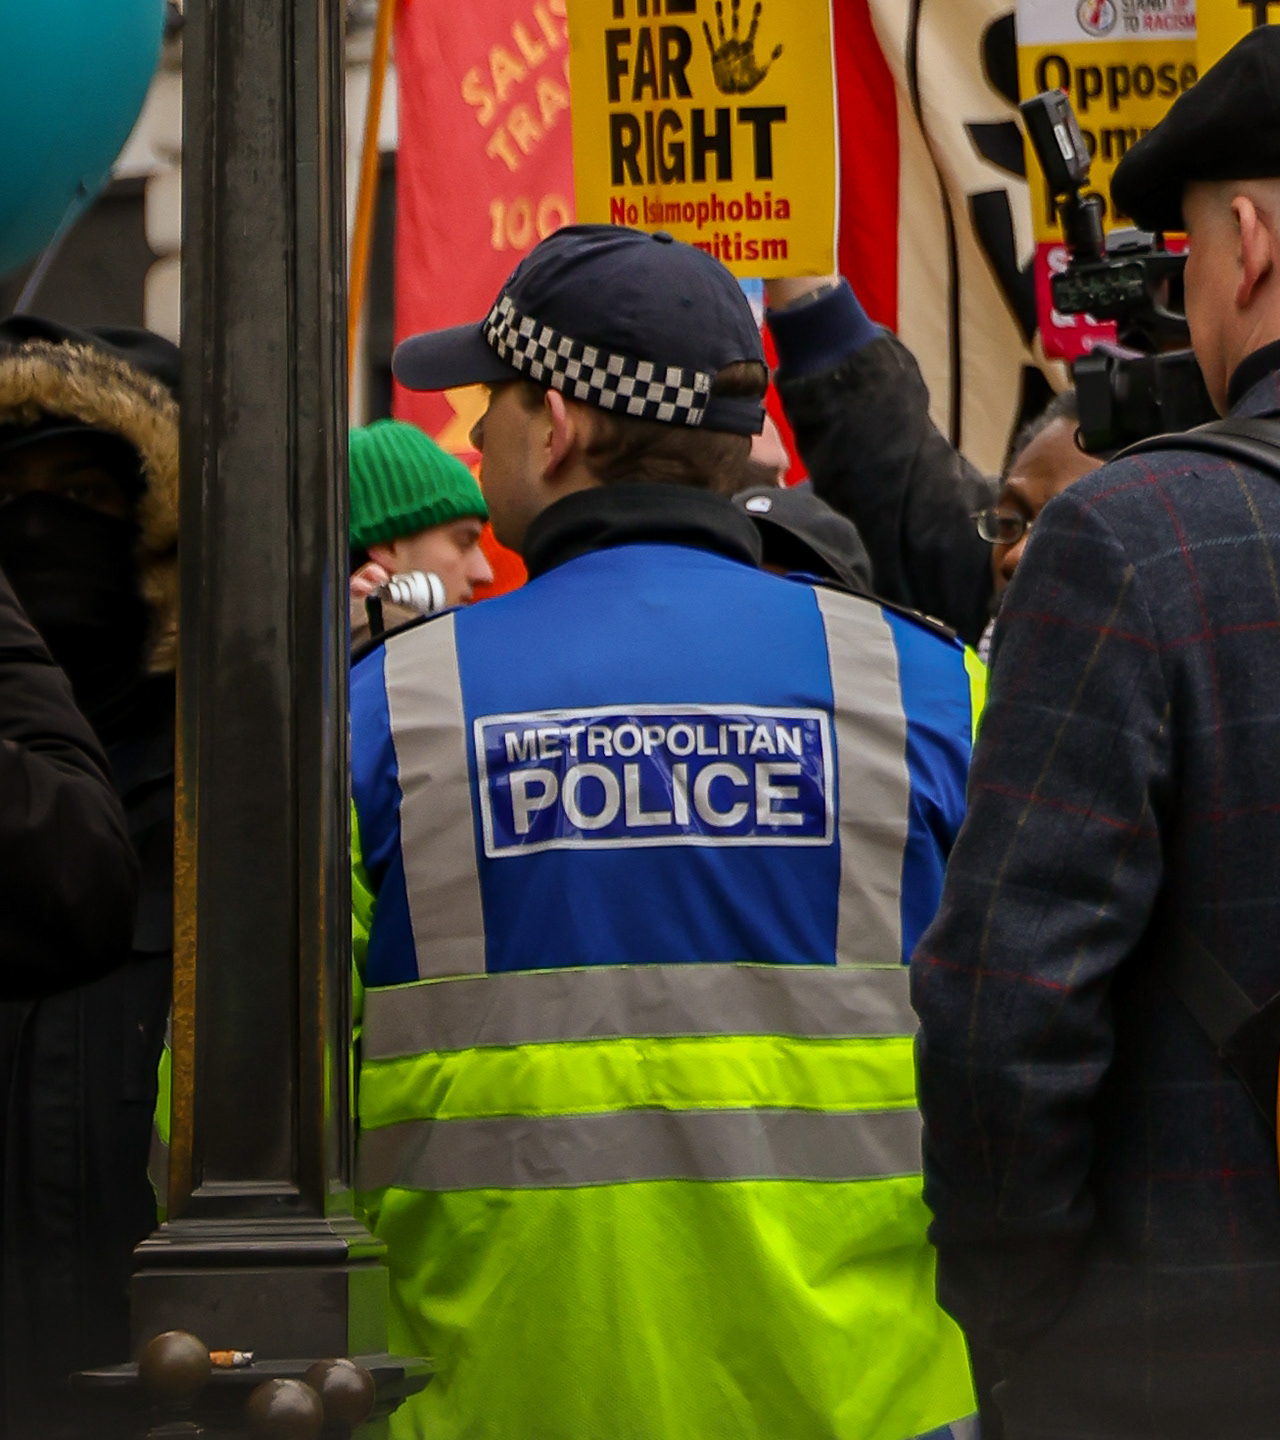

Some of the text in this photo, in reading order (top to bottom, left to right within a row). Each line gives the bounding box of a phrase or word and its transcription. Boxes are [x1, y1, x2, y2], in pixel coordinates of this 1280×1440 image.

[1123, 15, 1140, 33] TO
[604, 24, 694, 105] FAR
[1034, 53, 1199, 113] Oppose
[608, 105, 788, 188] RIGHT
[608, 195, 639, 225] No
[503, 723, 803, 763] METROPOLITAN
[507, 762, 806, 836] POLICE
